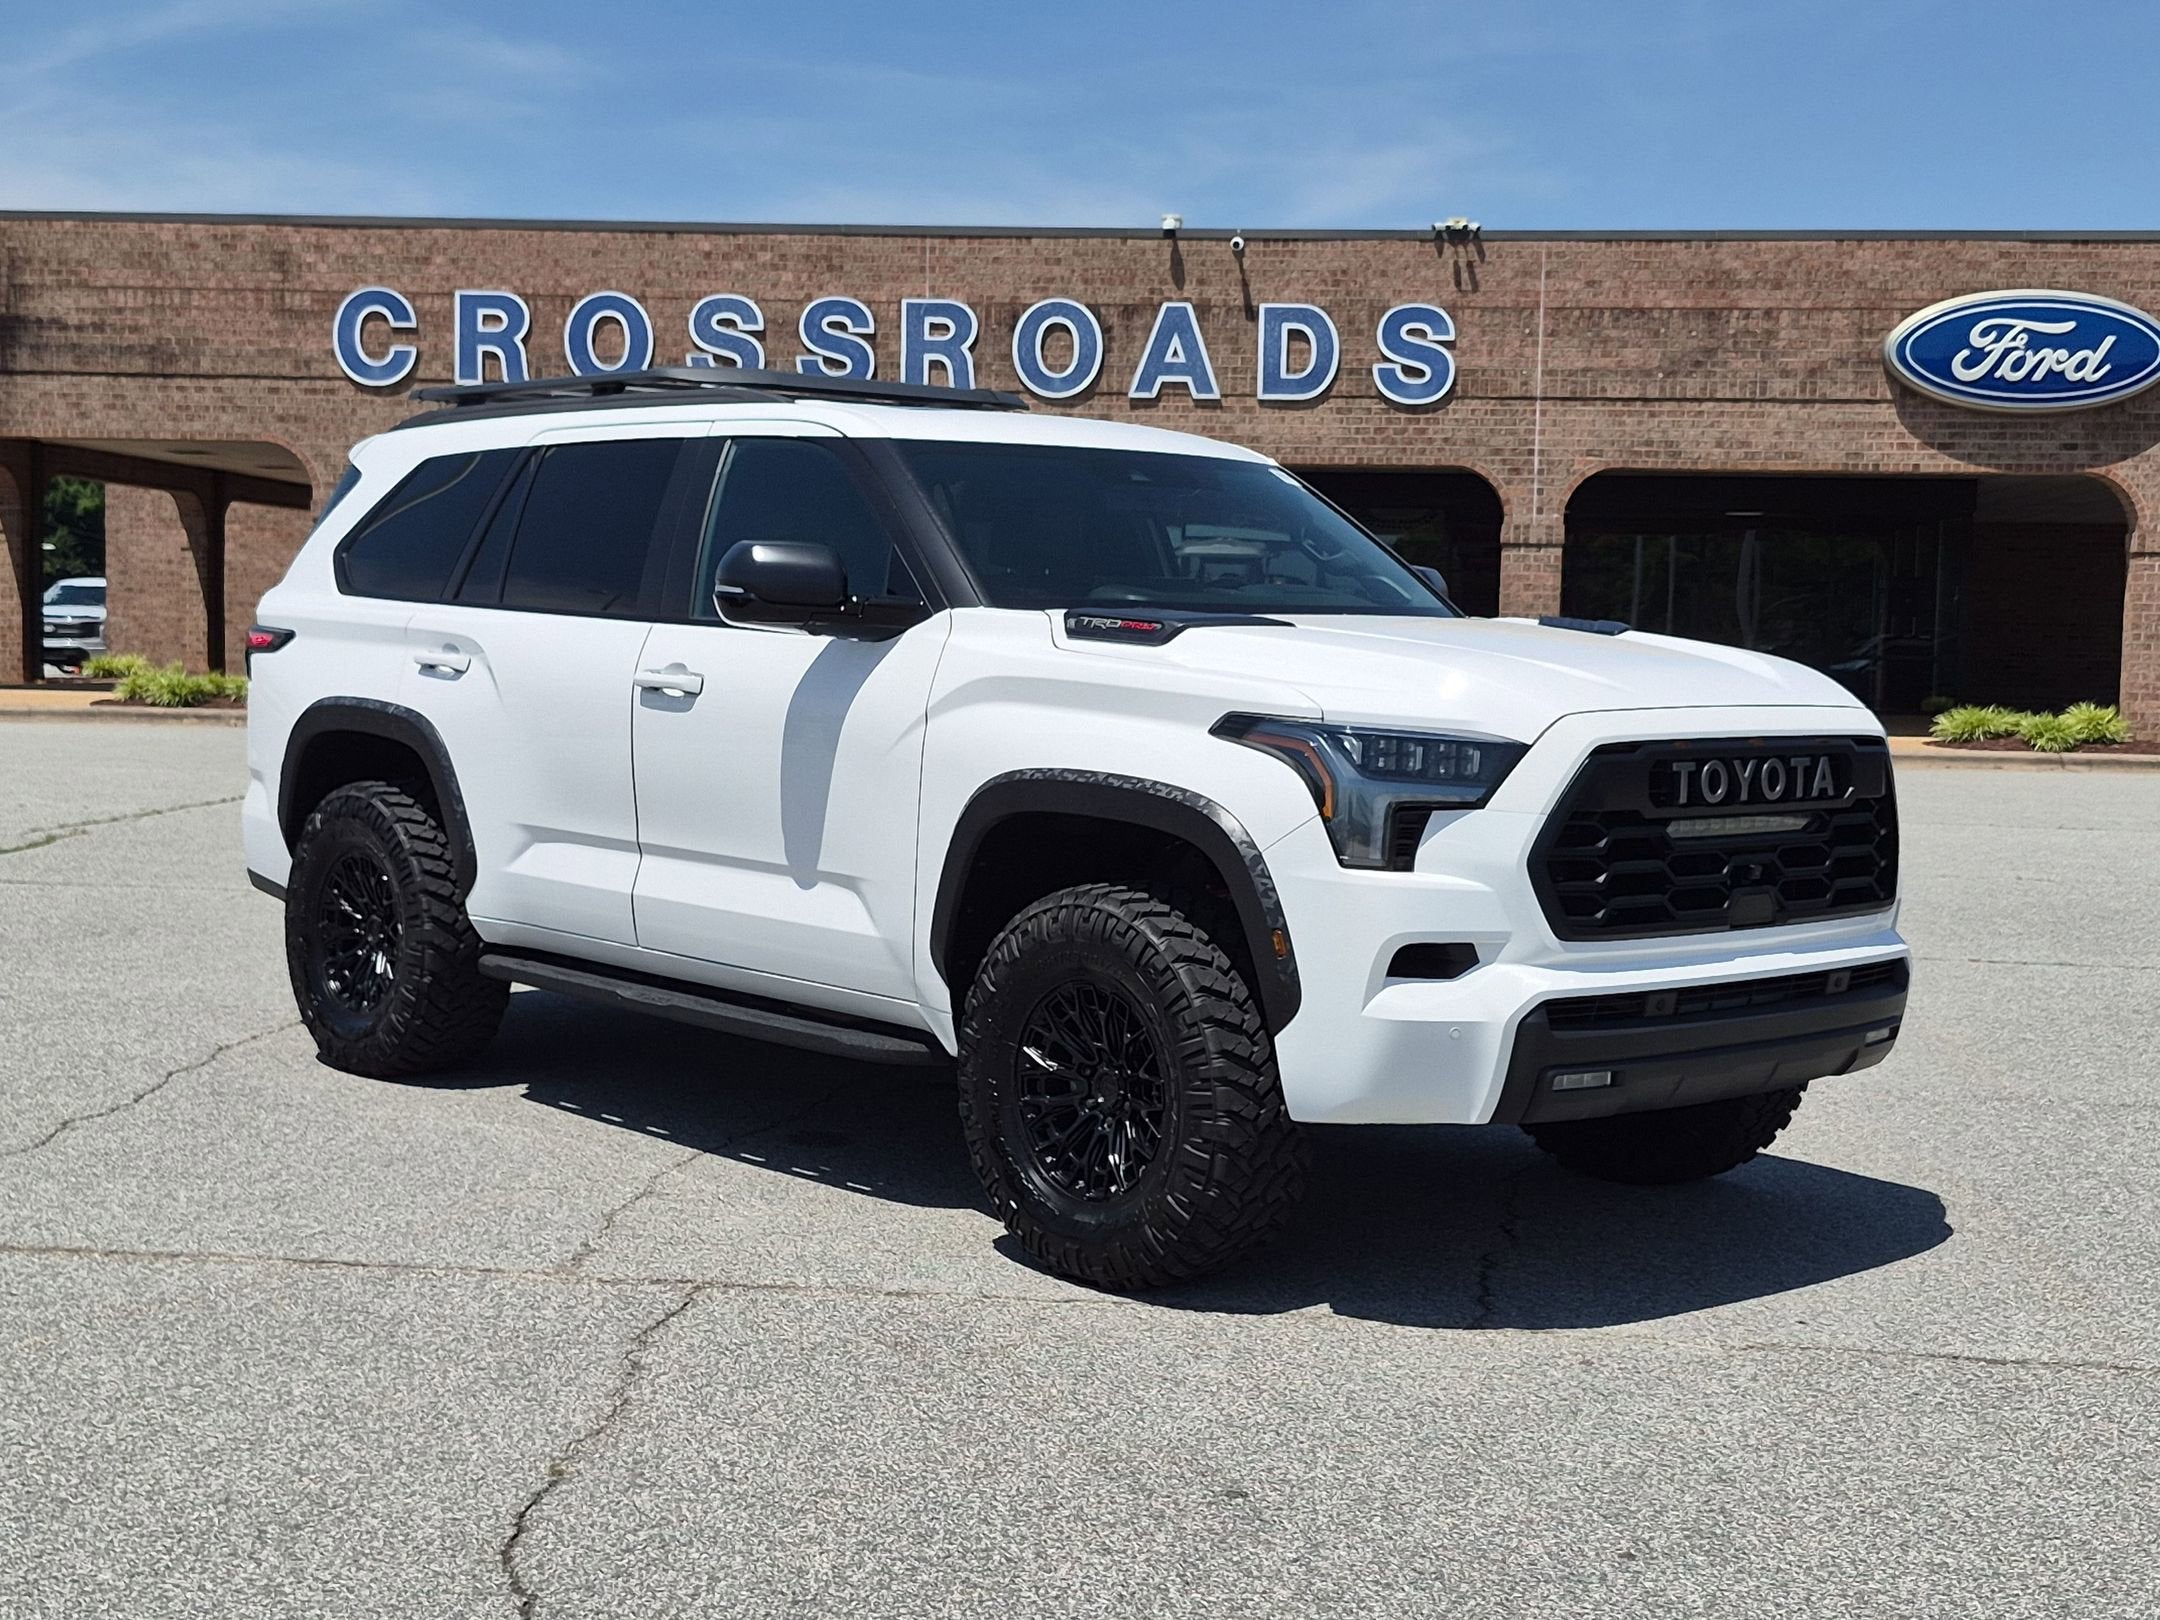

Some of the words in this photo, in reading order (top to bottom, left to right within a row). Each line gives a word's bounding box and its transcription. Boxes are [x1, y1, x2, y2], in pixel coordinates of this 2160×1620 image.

[332, 286, 1457, 405] CROSSROADS
[1951, 318, 2117, 382] Ford
[1080, 617, 1121, 629] TRD
[1672, 756, 1835, 804] TOYOTA
